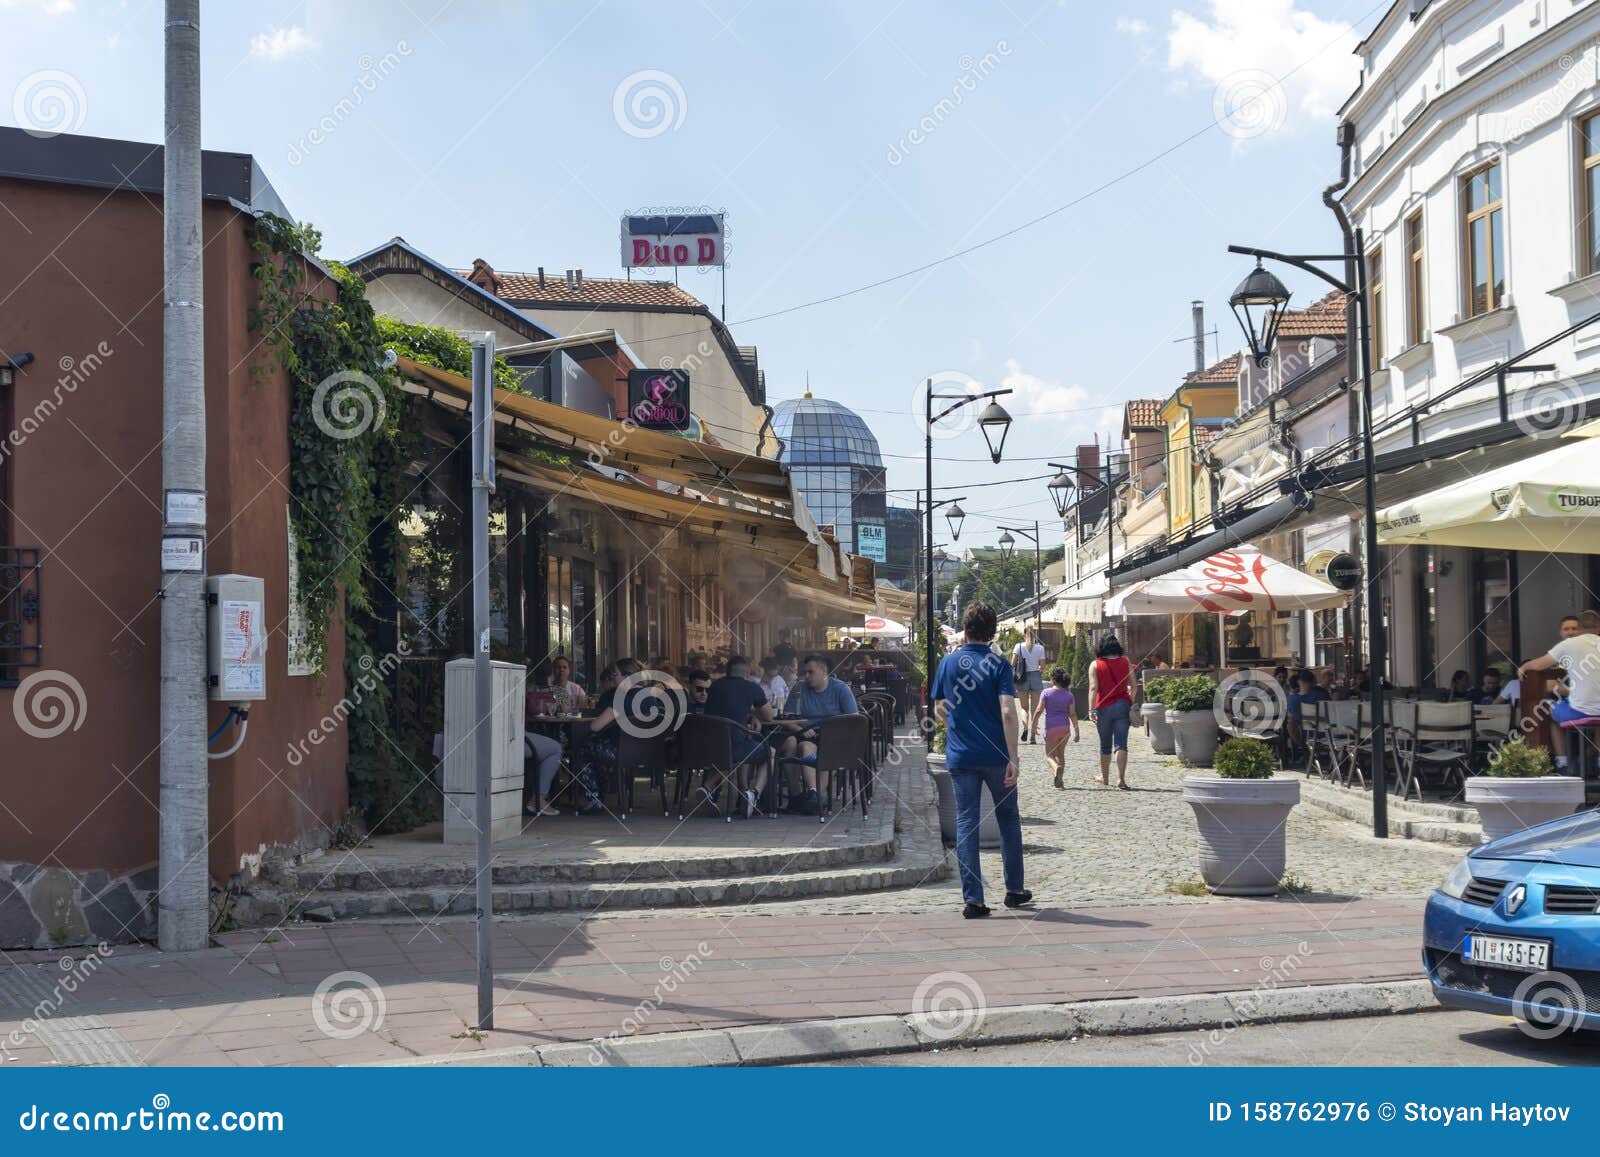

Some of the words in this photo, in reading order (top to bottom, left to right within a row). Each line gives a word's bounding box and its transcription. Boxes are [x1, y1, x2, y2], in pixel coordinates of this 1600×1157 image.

[632, 239, 690, 265] Duo
[697, 238, 715, 264] D
[863, 527, 882, 537] BLM
